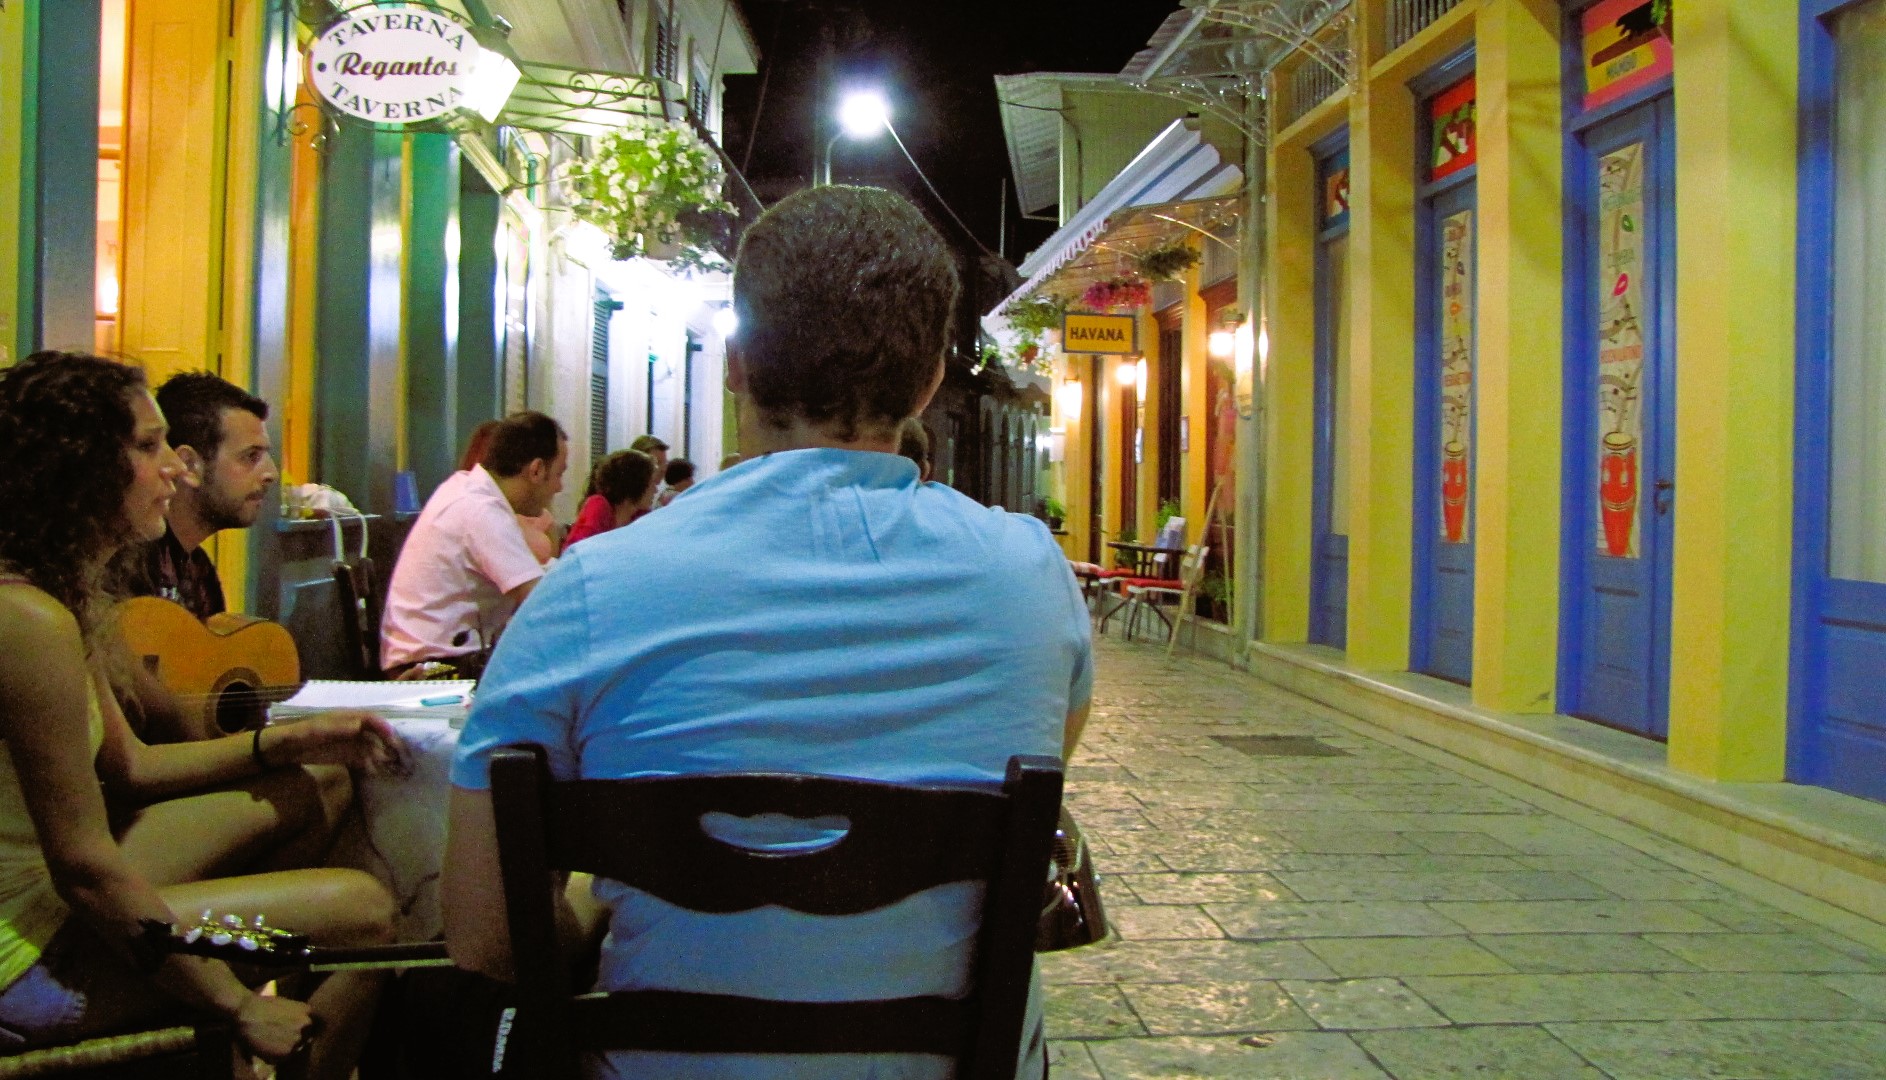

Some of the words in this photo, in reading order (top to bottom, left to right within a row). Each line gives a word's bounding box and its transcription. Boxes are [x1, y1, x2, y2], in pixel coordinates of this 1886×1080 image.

[328, 13, 465, 52] TAVERNA
[334, 52, 458, 81] Regantos
[331, 81, 464, 119] TAVERNA
[1070, 327, 1124, 341] HAVANA
